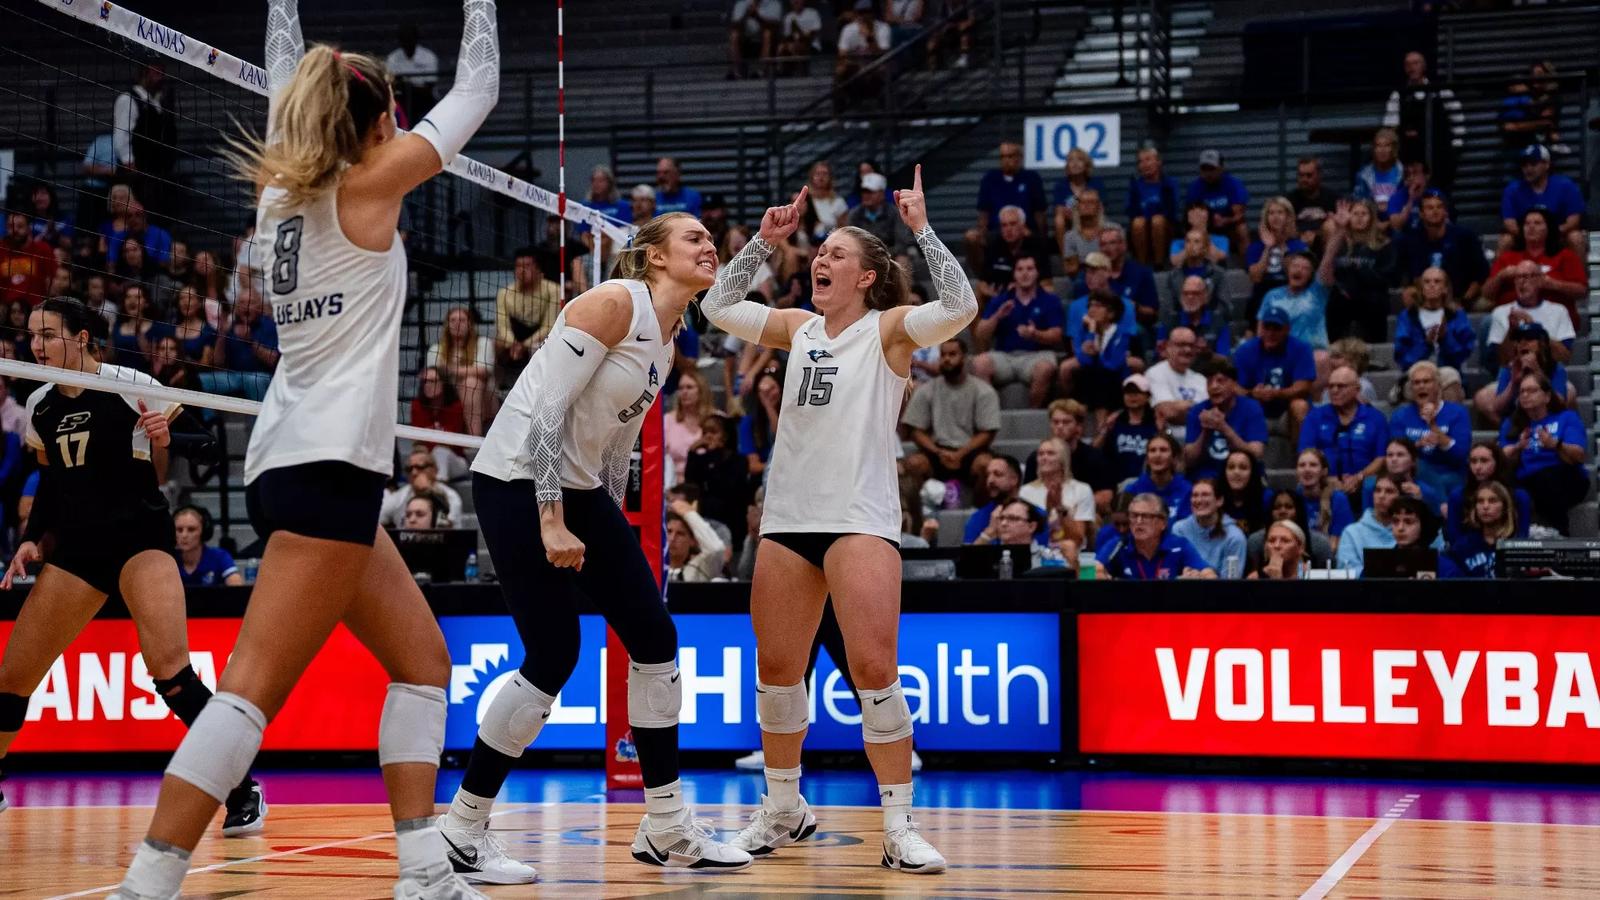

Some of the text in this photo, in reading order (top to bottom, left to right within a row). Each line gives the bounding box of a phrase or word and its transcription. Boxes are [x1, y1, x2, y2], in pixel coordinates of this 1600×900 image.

[136, 15, 187, 56] KANSAS
[238, 61, 269, 92] KANS
[1034, 122, 1109, 161] 102
[271, 214, 303, 295] 8
[617, 390, 655, 424] 5
[797, 366, 839, 407] 15
[55, 429, 91, 468] 17
[24, 651, 232, 721] ANS
[545, 646, 742, 724] LH
[1154, 647, 1600, 728] VOLLEYBA
